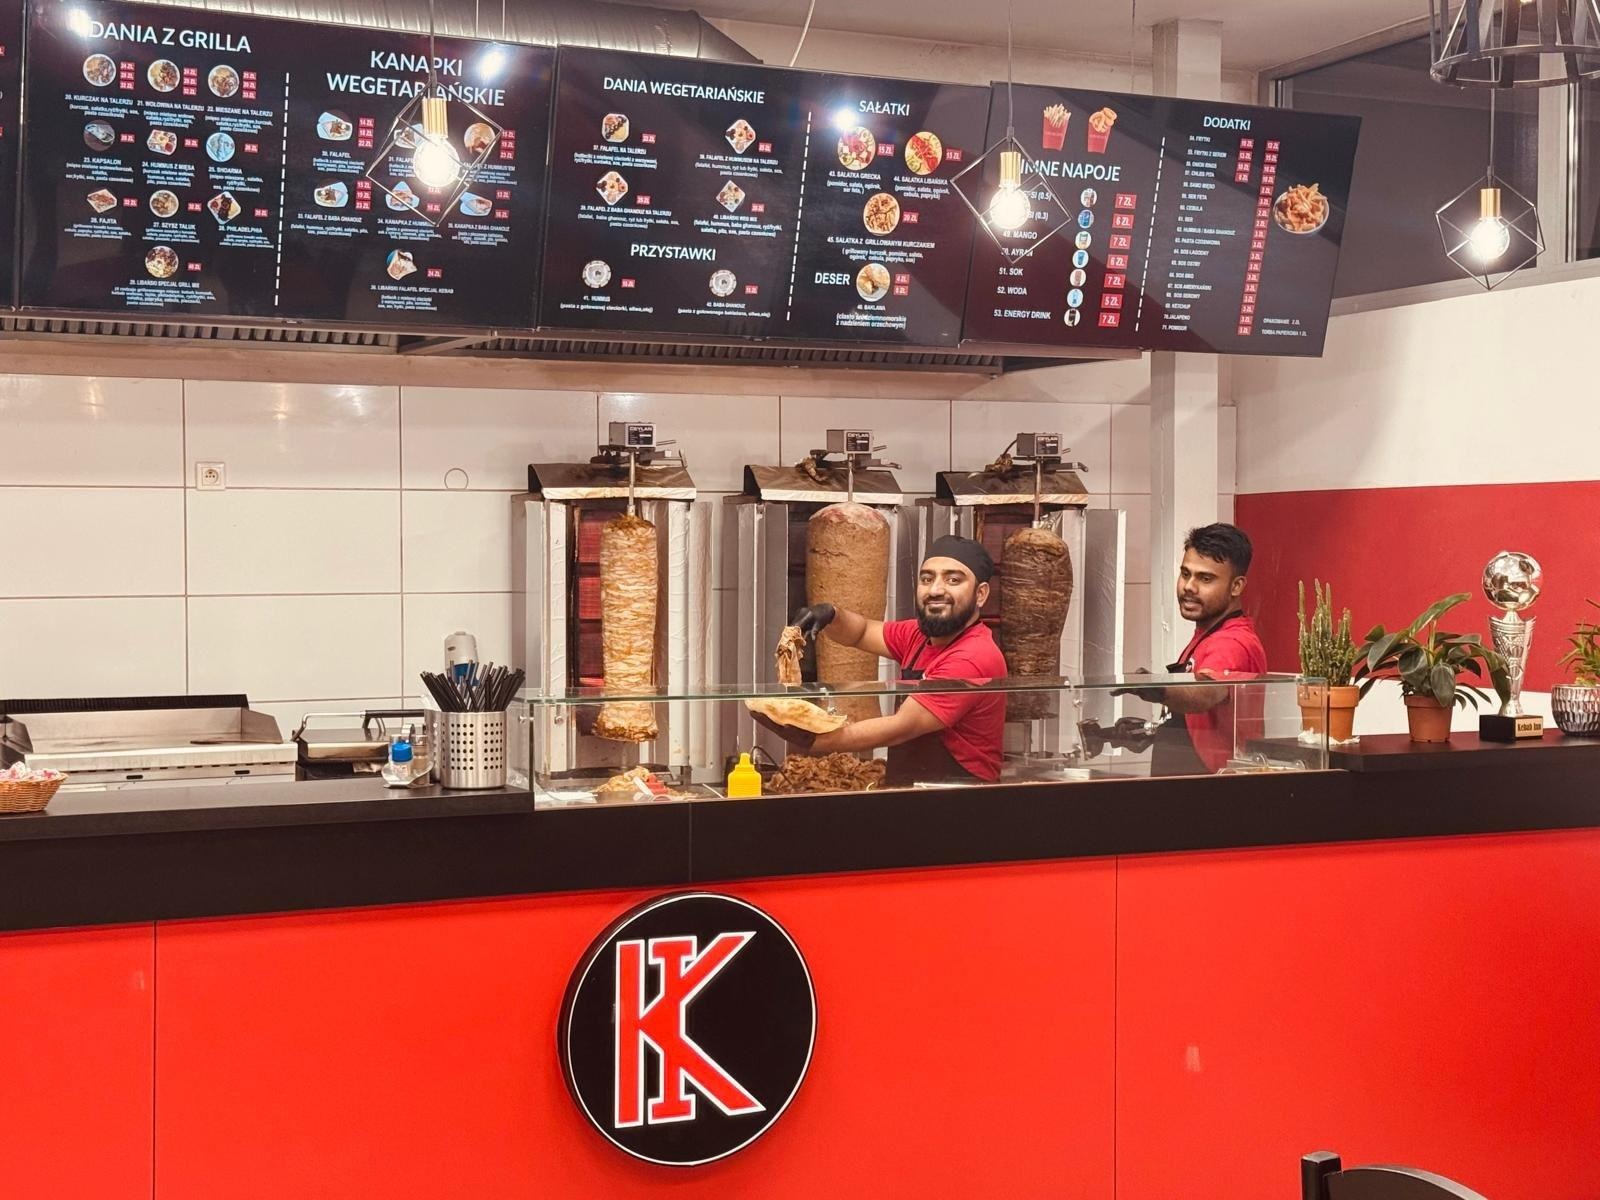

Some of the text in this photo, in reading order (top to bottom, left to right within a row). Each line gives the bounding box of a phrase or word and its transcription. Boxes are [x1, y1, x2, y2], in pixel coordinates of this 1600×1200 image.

[90, 21, 251, 52] DANIA Z GRILLA
[370, 50, 462, 76] KANAPKI
[604, 78, 765, 104] DANIA WEGETARIAŃSKIE
[859, 100, 910, 116] SAŁATKI
[1203, 116, 1250, 131] DODATKI
[1020, 159, 1120, 181] IMNE NAPOJE
[1013, 231, 1037, 240] MANGO
[631, 244, 716, 260] PRZYSTAWKI
[815, 272, 850, 285] DESER
[1008, 287, 1027, 295] WODA
[1004, 310, 1030, 319] ENERGY
[1031, 311, 1051, 319] DRINK
